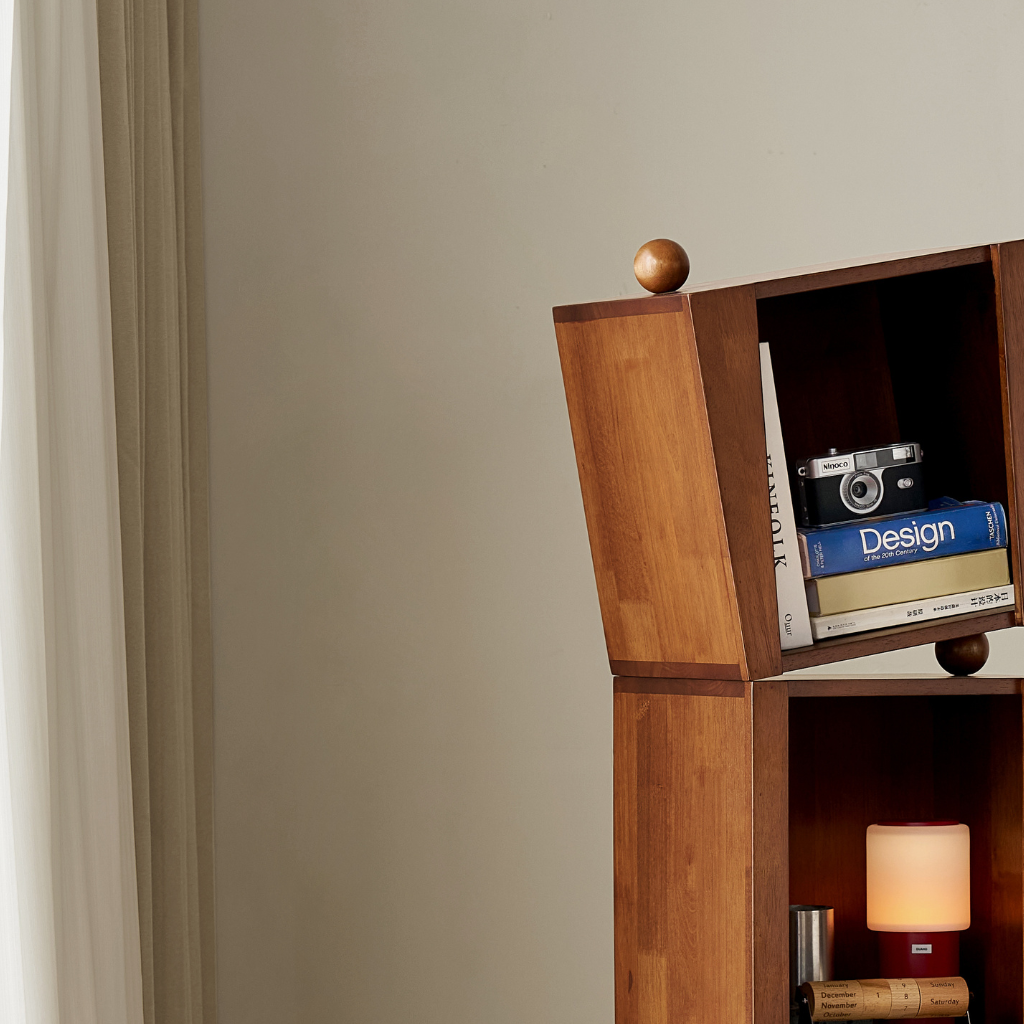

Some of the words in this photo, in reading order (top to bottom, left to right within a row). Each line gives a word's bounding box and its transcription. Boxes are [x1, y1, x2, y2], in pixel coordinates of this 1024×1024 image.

[985, 511, 995, 540] TASCHEN
[859, 520, 955, 555] Design
[895, 548, 918, 556] Century
[930, 998, 960, 1006] Saturday
